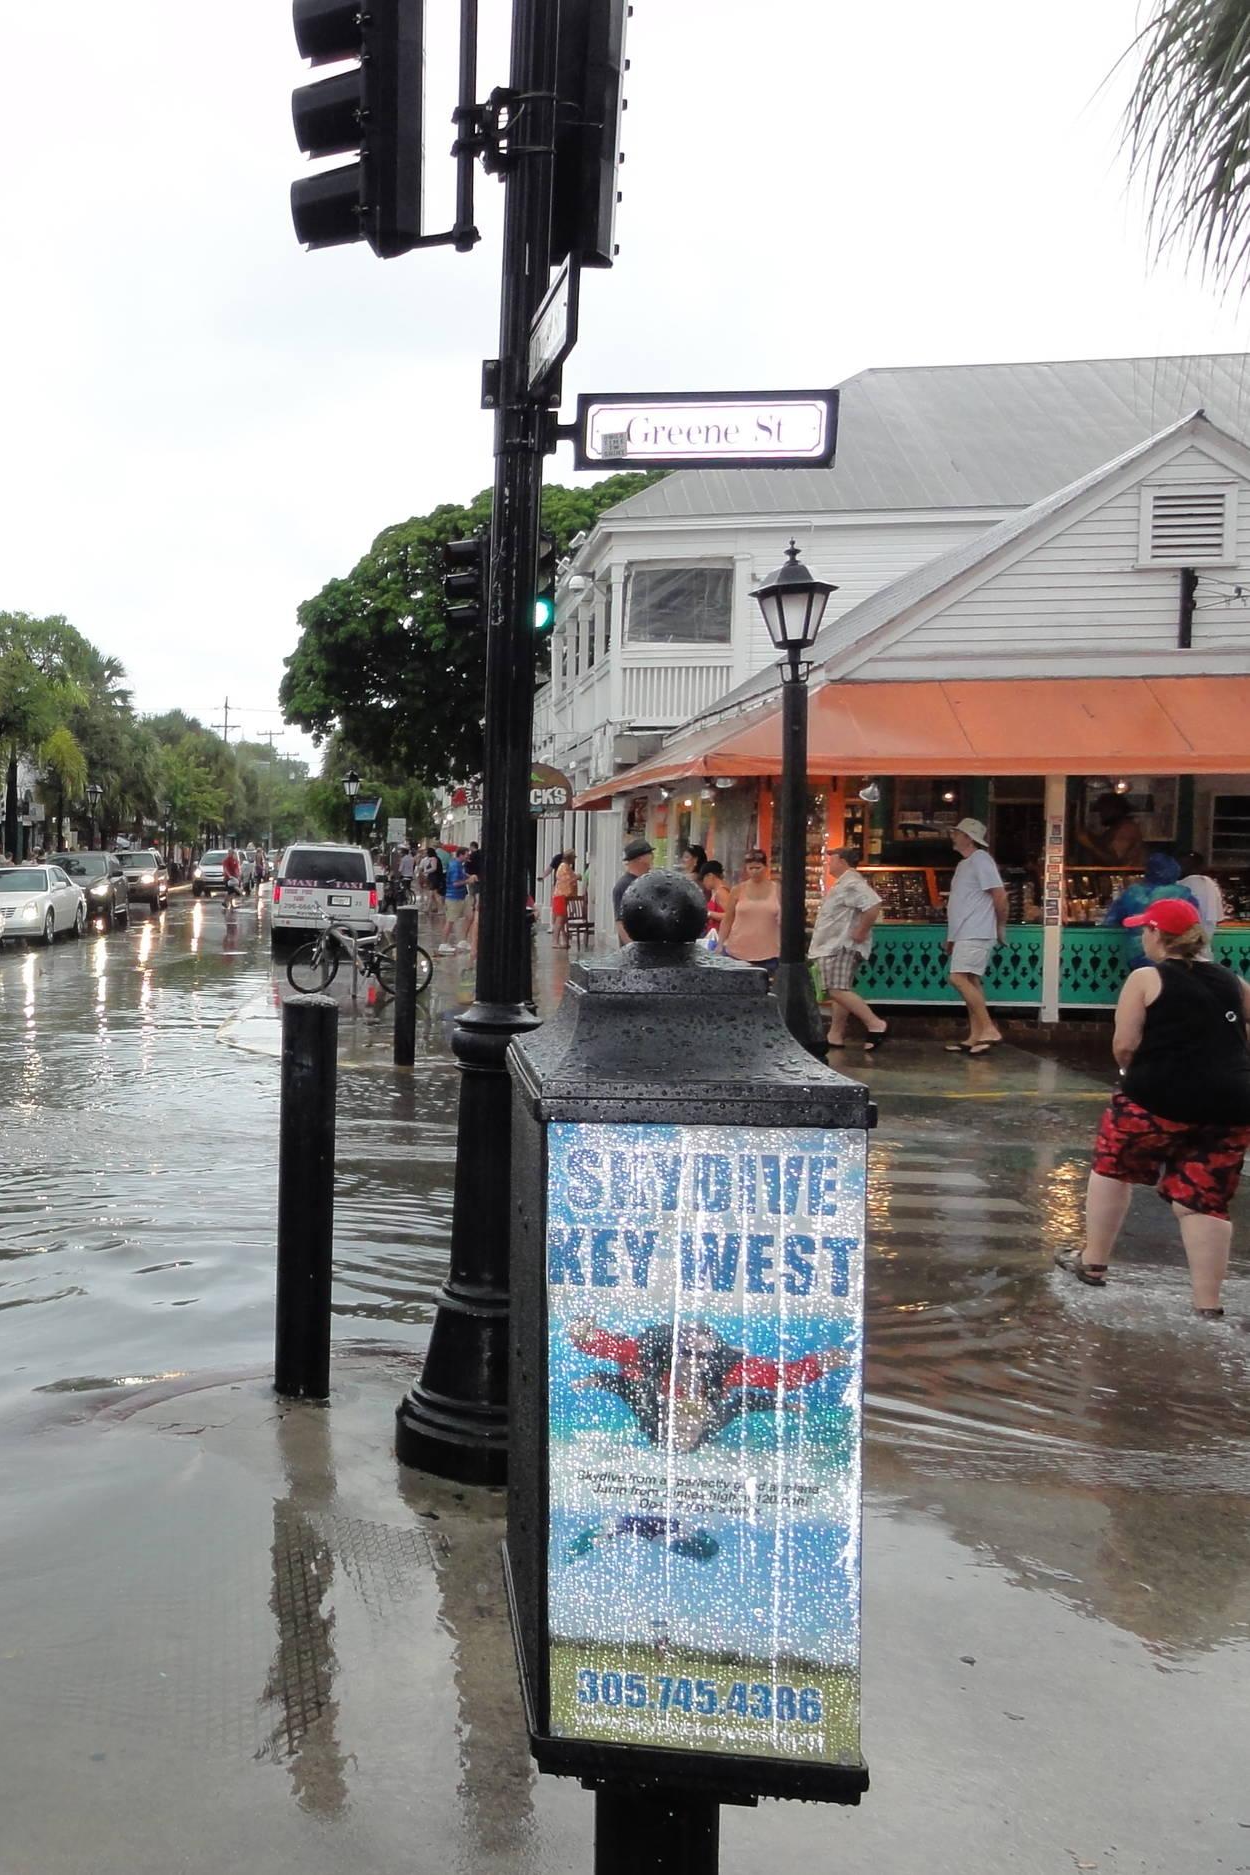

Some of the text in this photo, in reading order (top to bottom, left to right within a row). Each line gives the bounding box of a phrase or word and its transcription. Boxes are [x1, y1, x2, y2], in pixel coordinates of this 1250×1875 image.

[626, 416, 740, 445] Greene
[754, 415, 782, 443] St
[530, 786, 567, 805] CK'S
[284, 879, 363, 889] MAXI TAXI
[567, 1149, 838, 1216] SKYDIVE
[549, 1227, 859, 1297] KEY WEST
[577, 1470, 626, 1483] Skydive
[629, 1473, 656, 1485] from
[734, 1480, 766, 1492] gd
[593, 1483, 627, 1497] Jump
[630, 1485, 658, 1497] from
[756, 1494, 778, 1505] 120
